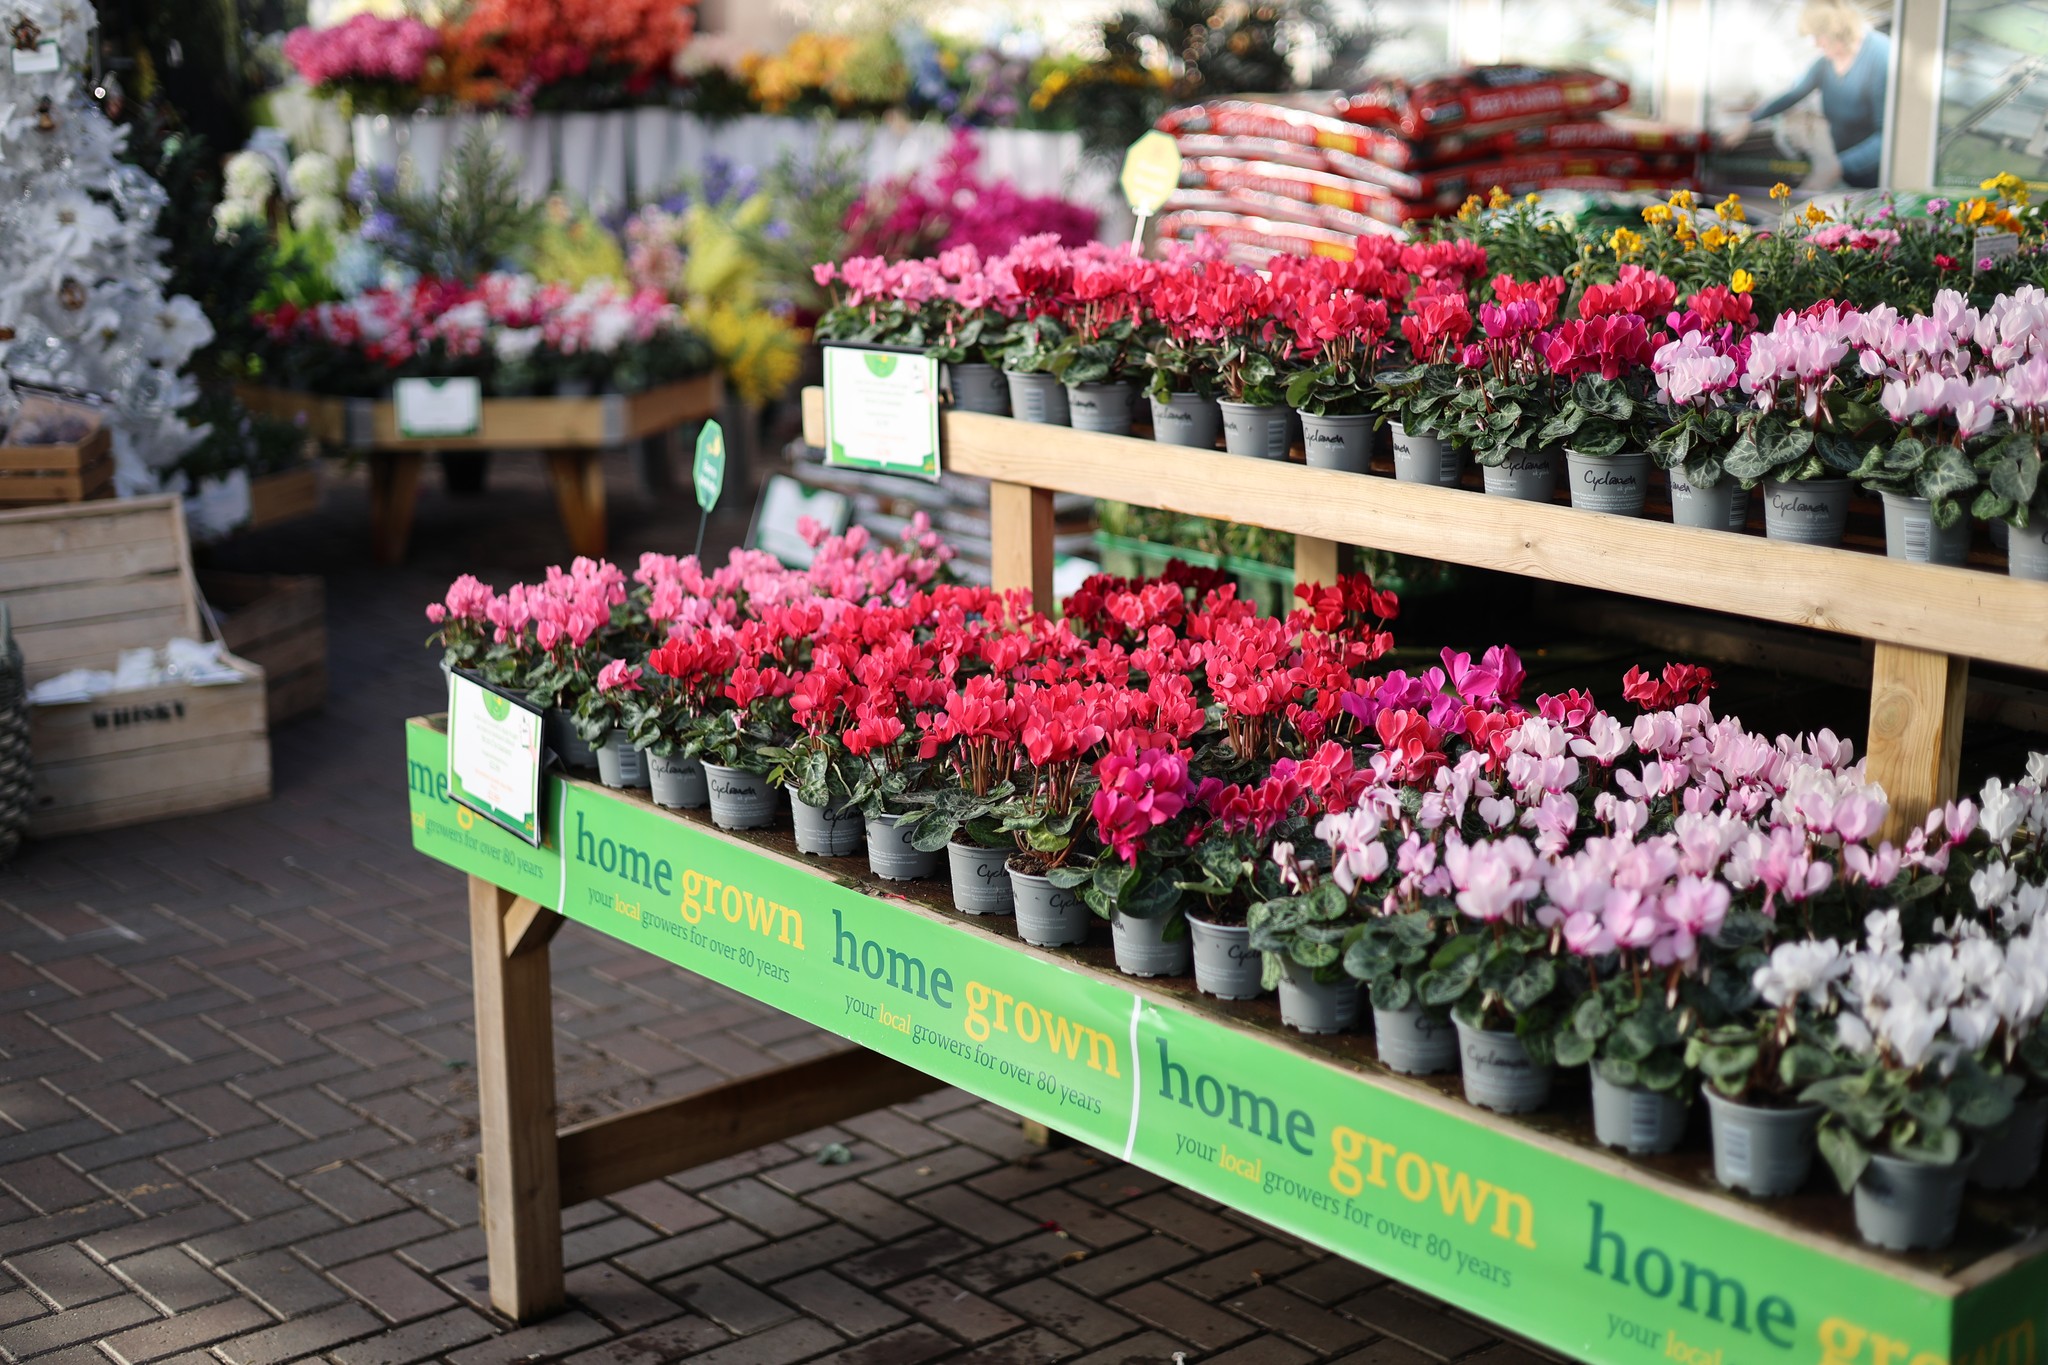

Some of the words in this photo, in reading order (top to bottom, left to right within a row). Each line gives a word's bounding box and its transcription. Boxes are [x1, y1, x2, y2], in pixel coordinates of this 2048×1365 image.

[1584, 470, 1637, 492] Cyclamen
[1772, 494, 1829, 522] Cyclamen
[711, 779, 758, 799] Cyclamen
[426, 818, 463, 844] growers
[464, 831, 479, 851] for
[480, 842, 503, 860] over
[503, 846, 516, 867] 80
[516, 856, 544, 879] years
[575, 811, 673, 896] home
[682, 868, 805, 951] grown
[588, 886, 614, 911] your
[614, 893, 641, 921] local
[641, 910, 689, 945] growers
[690, 926, 709, 953] for
[710, 938, 738, 962] over
[738, 943, 755, 967] 80
[755, 957, 791, 985] years
[832, 908, 954, 1009] home
[963, 980, 1121, 1079] grown
[844, 993, 877, 1020] your
[878, 1003, 911, 1035] local
[912, 1022, 972, 1061] growers
[974, 1043, 999, 1071] for
[999, 1059, 1035, 1086] over
[1036, 1071, 1057, 1096] 80
[1058, 1081, 1102, 1115] years
[1155, 1037, 1316, 1157] home
[1329, 1125, 1537, 1250] grown
[1175, 1132, 1218, 1163] your
[1218, 1144, 1261, 1184] local
[1263, 1170, 1340, 1215] growers
[1343, 1197, 1370, 1229] for
[1376, 1218, 1423, 1250] over
[1425, 1233, 1452, 1262] 80
[1454, 1248, 1512, 1288] years
[1583, 1200, 1797, 1351] home
[1606, 1311, 1663, 1349] your
